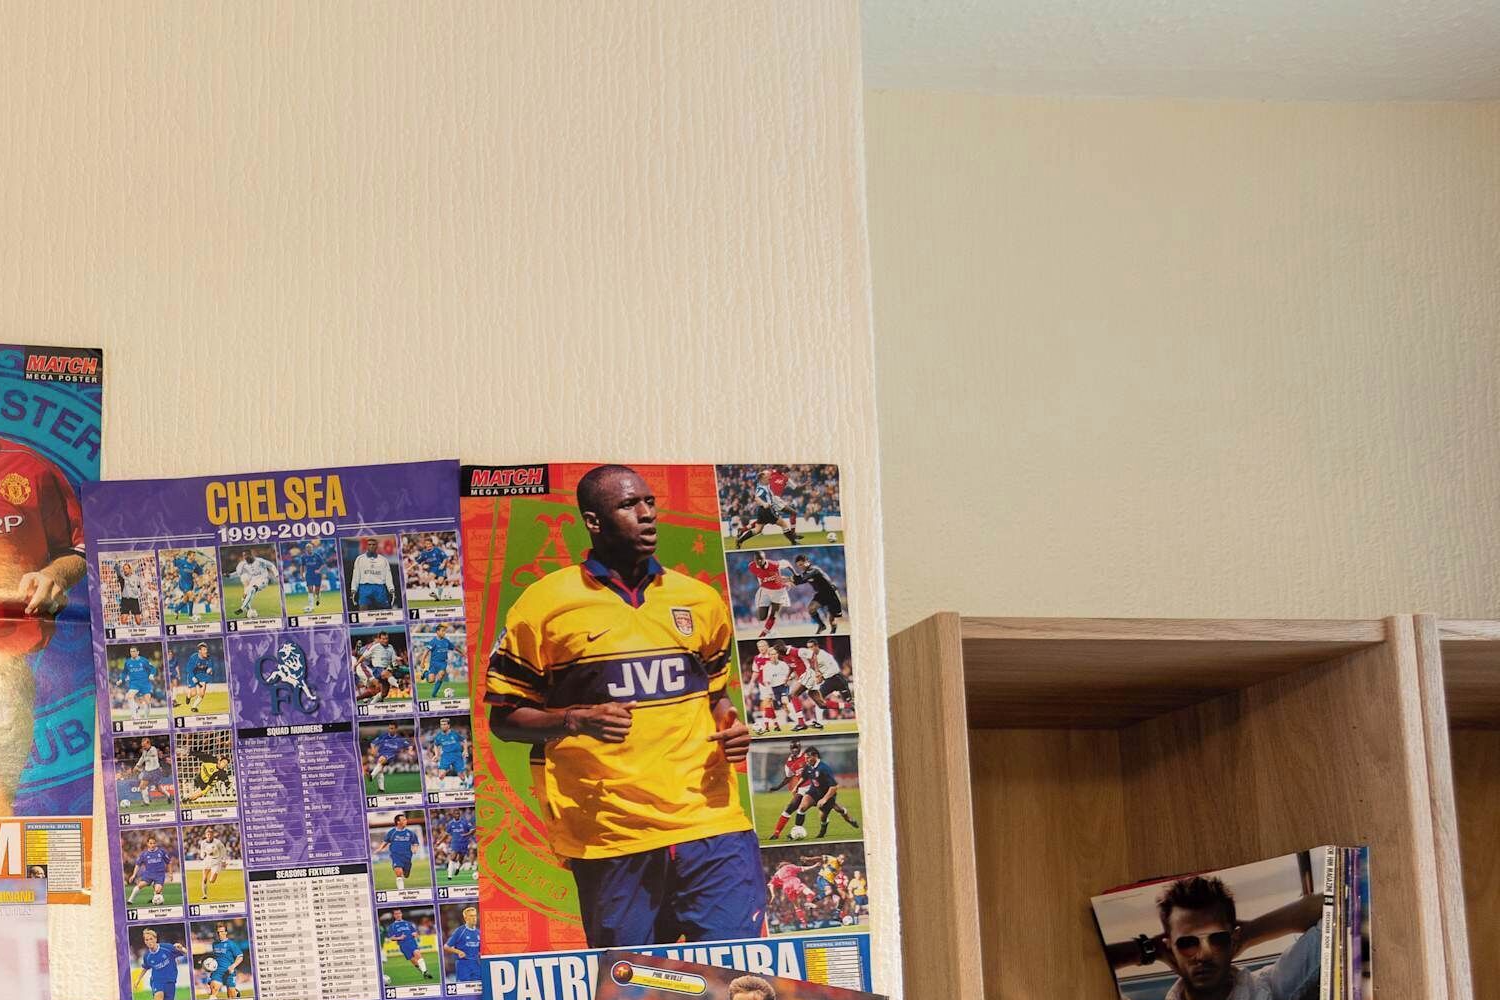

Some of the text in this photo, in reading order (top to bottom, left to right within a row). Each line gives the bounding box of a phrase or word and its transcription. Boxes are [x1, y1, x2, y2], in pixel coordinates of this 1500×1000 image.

[27, 354, 98, 375] MATCH
[25, 373, 98, 384] MEGA POSTER
[471, 468, 543, 487] MATCH
[471, 486, 544, 496] MEGA POSTER
[205, 475, 347, 525] CHELSEA
[218, 521, 336, 543] 1999-2000
[411, 610, 418, 619] 7
[229, 621, 236, 631] 3
[290, 617, 297, 627] 5
[107, 629, 114, 639] 1
[168, 625, 176, 635] 2
[607, 657, 686, 697] JVC
[419, 702, 428, 711] 11
[176, 717, 183, 727] 9
[266, 725, 323, 737] SQUAD NUMBERS
[367, 797, 378, 808] 14
[120, 814, 130, 825] 12
[182, 810, 192, 820] 13
[275, 866, 340, 879] SEASONS FIXTURES
[438, 888, 448, 898] 21
[127, 910, 138, 920] 17
[189, 906, 200, 916] 19
